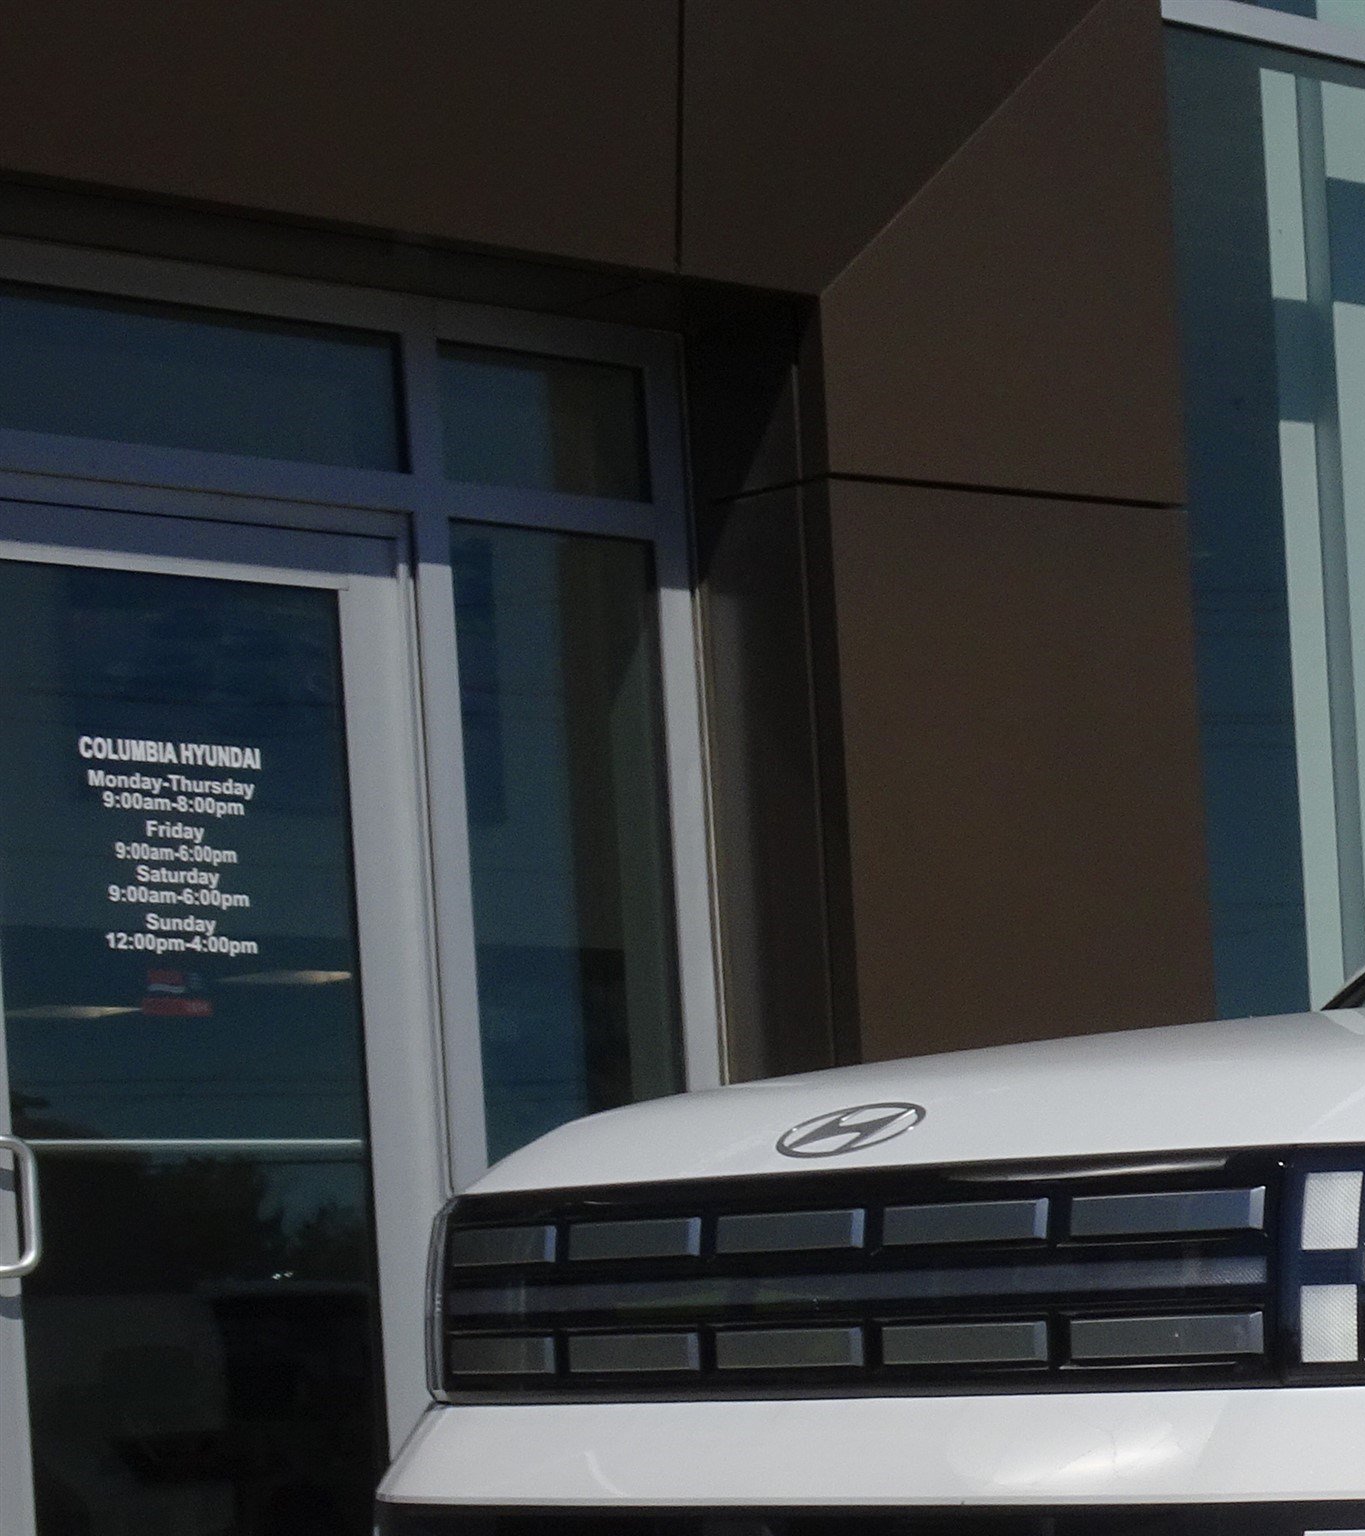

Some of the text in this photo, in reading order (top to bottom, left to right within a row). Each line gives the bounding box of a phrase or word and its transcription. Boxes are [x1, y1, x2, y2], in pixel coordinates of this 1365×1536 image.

[78, 735, 262, 770] COLUMBIA HYUNDAI
[87, 769, 255, 800] Monday-Thursday
[102, 790, 245, 818] 9:00am-8:00pm
[145, 820, 205, 843] Friday
[115, 841, 238, 866] 9:00am-6:00pm
[135, 864, 220, 889] Saturday
[107, 884, 250, 910] 9:00am-6:00pm
[145, 912, 217, 936] Sunday
[105, 932, 258, 957] 12:00pm-4:00pm
